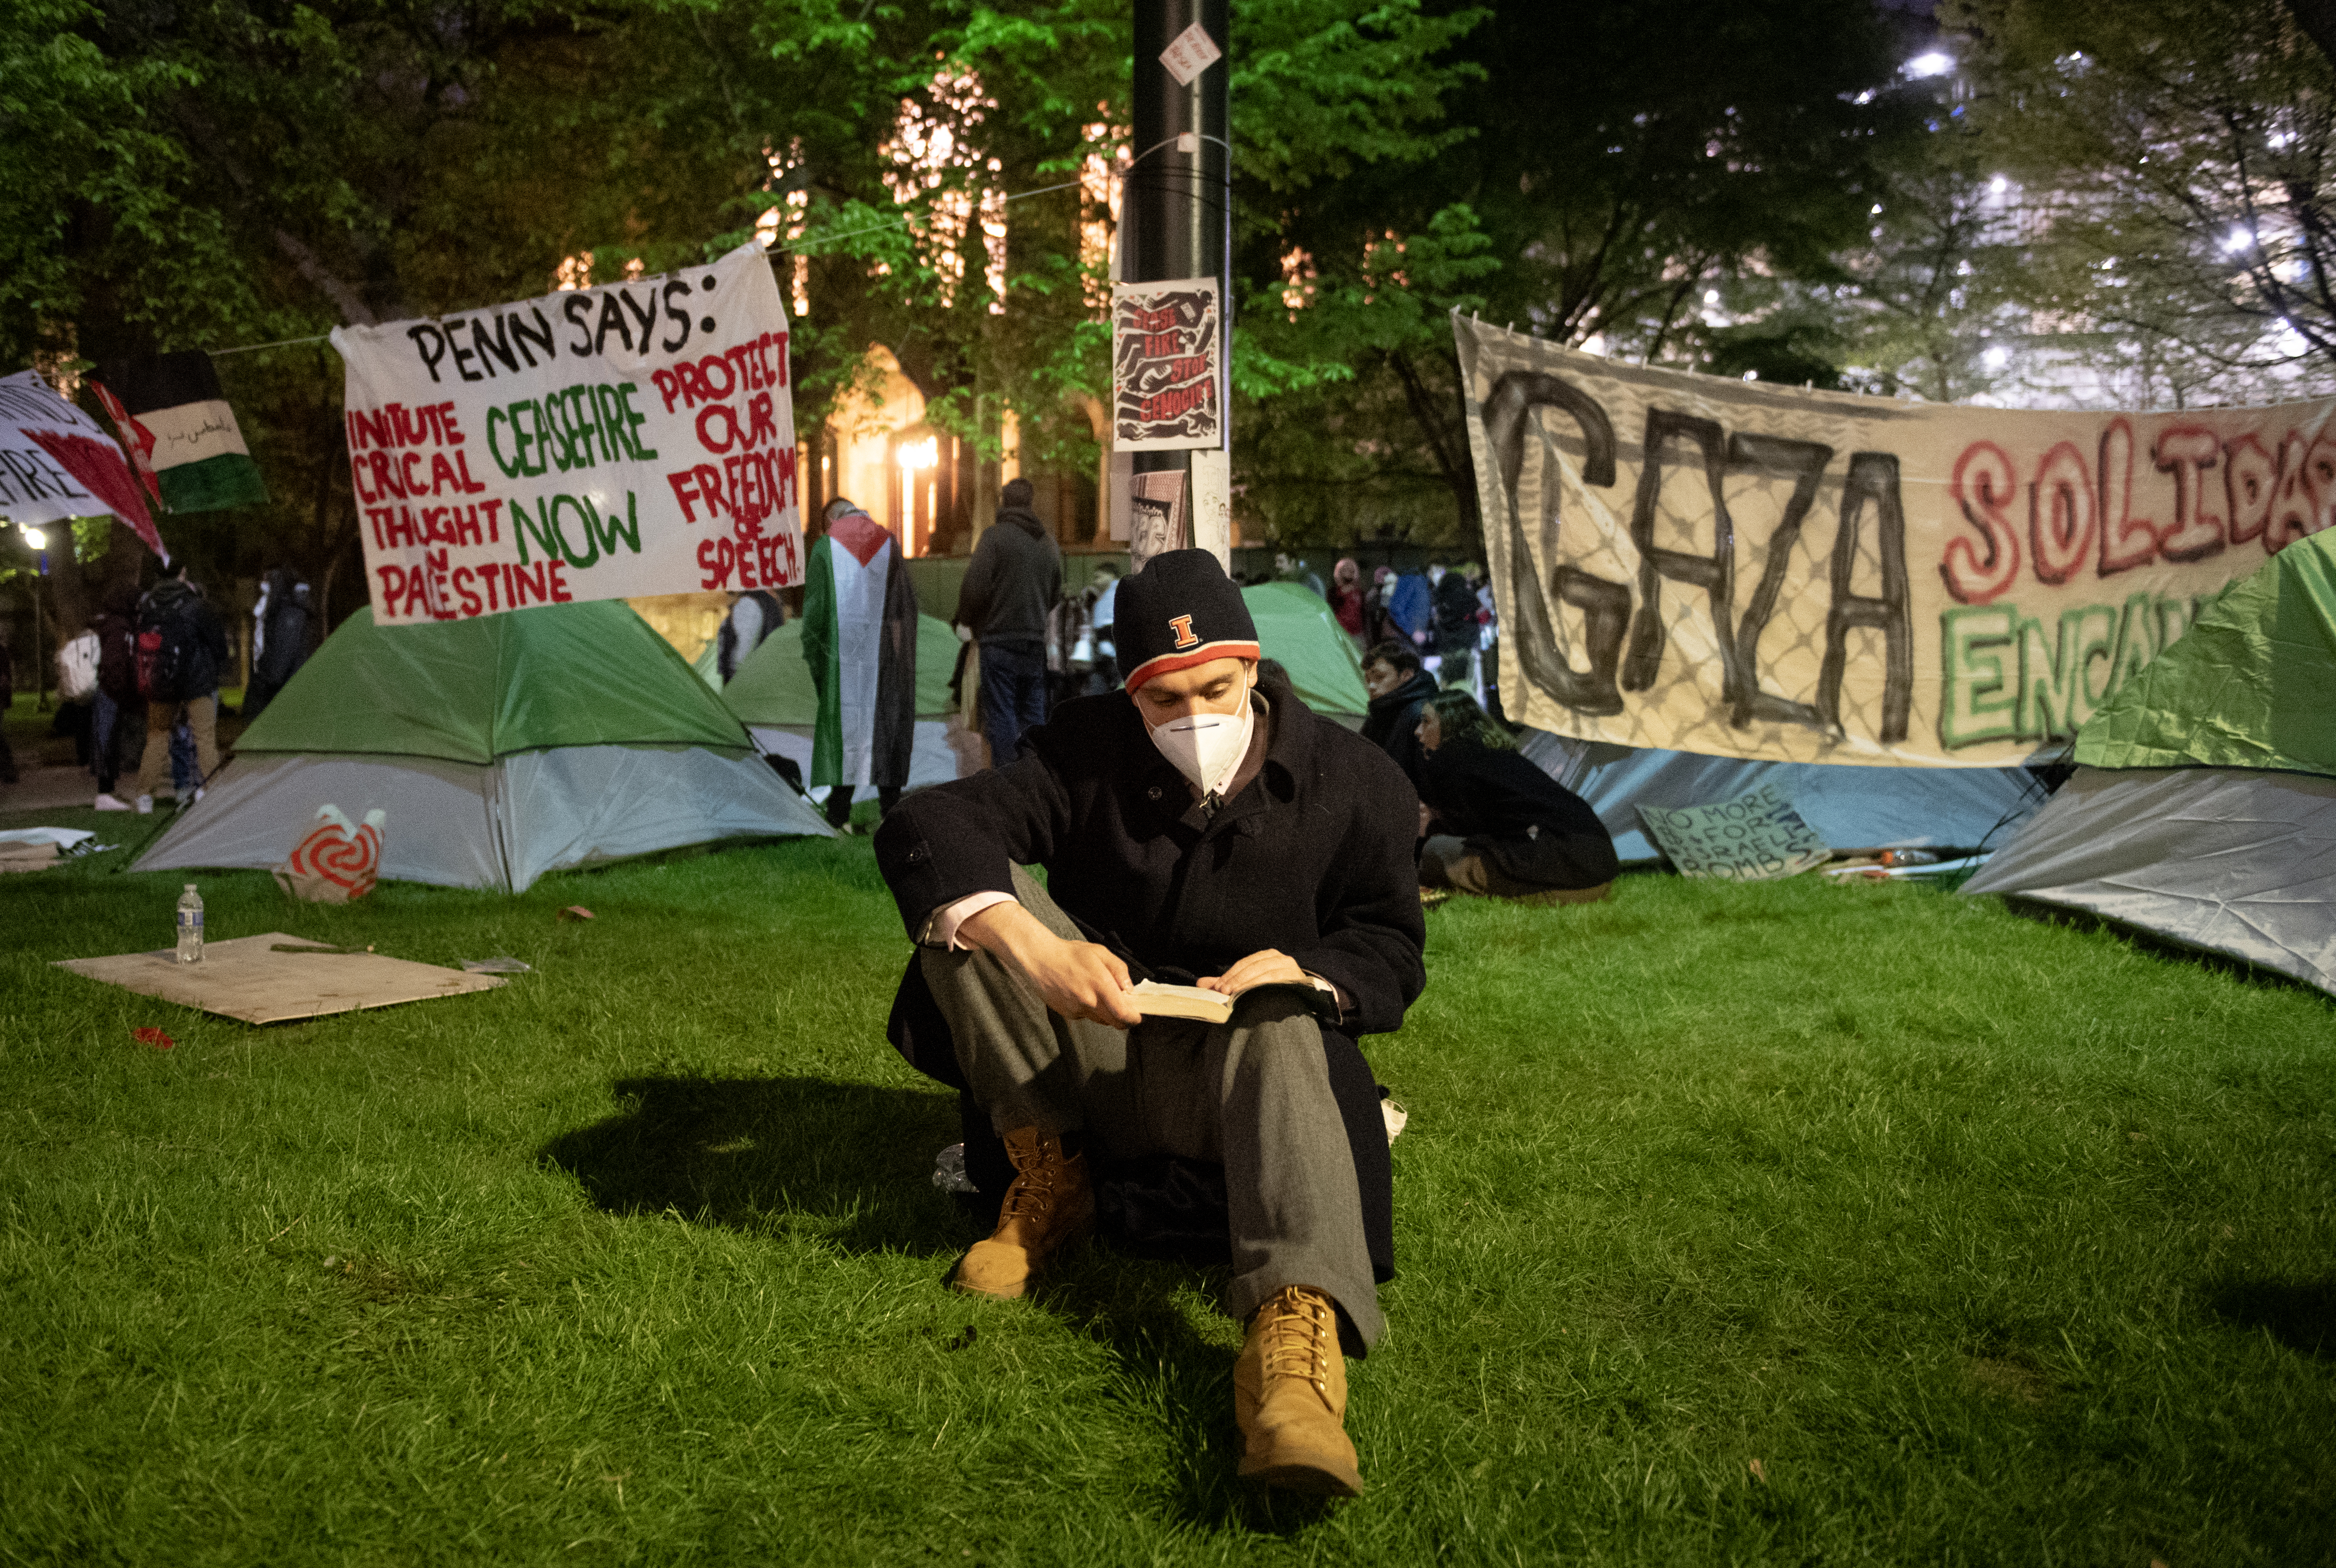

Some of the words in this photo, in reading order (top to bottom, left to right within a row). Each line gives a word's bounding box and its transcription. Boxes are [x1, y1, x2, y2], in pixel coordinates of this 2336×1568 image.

[406, 306, 556, 383] PENN
[564, 274, 716, 357] SAYS:
[1145, 332, 1180, 356] FIRE
[651, 331, 789, 414] PROTECT
[1170, 353, 1207, 382] STOP
[486, 382, 658, 479] CEASEFIRE
[695, 391, 777, 455] OUR
[1140, 379, 1213, 422] GENOCIDE
[509, 490, 641, 569] NOW
[1481, 370, 1913, 744] GAZA
[1642, 806, 1692, 830] NO
[1701, 783, 1781, 823] MORE
[1702, 816, 1771, 843] FOR
